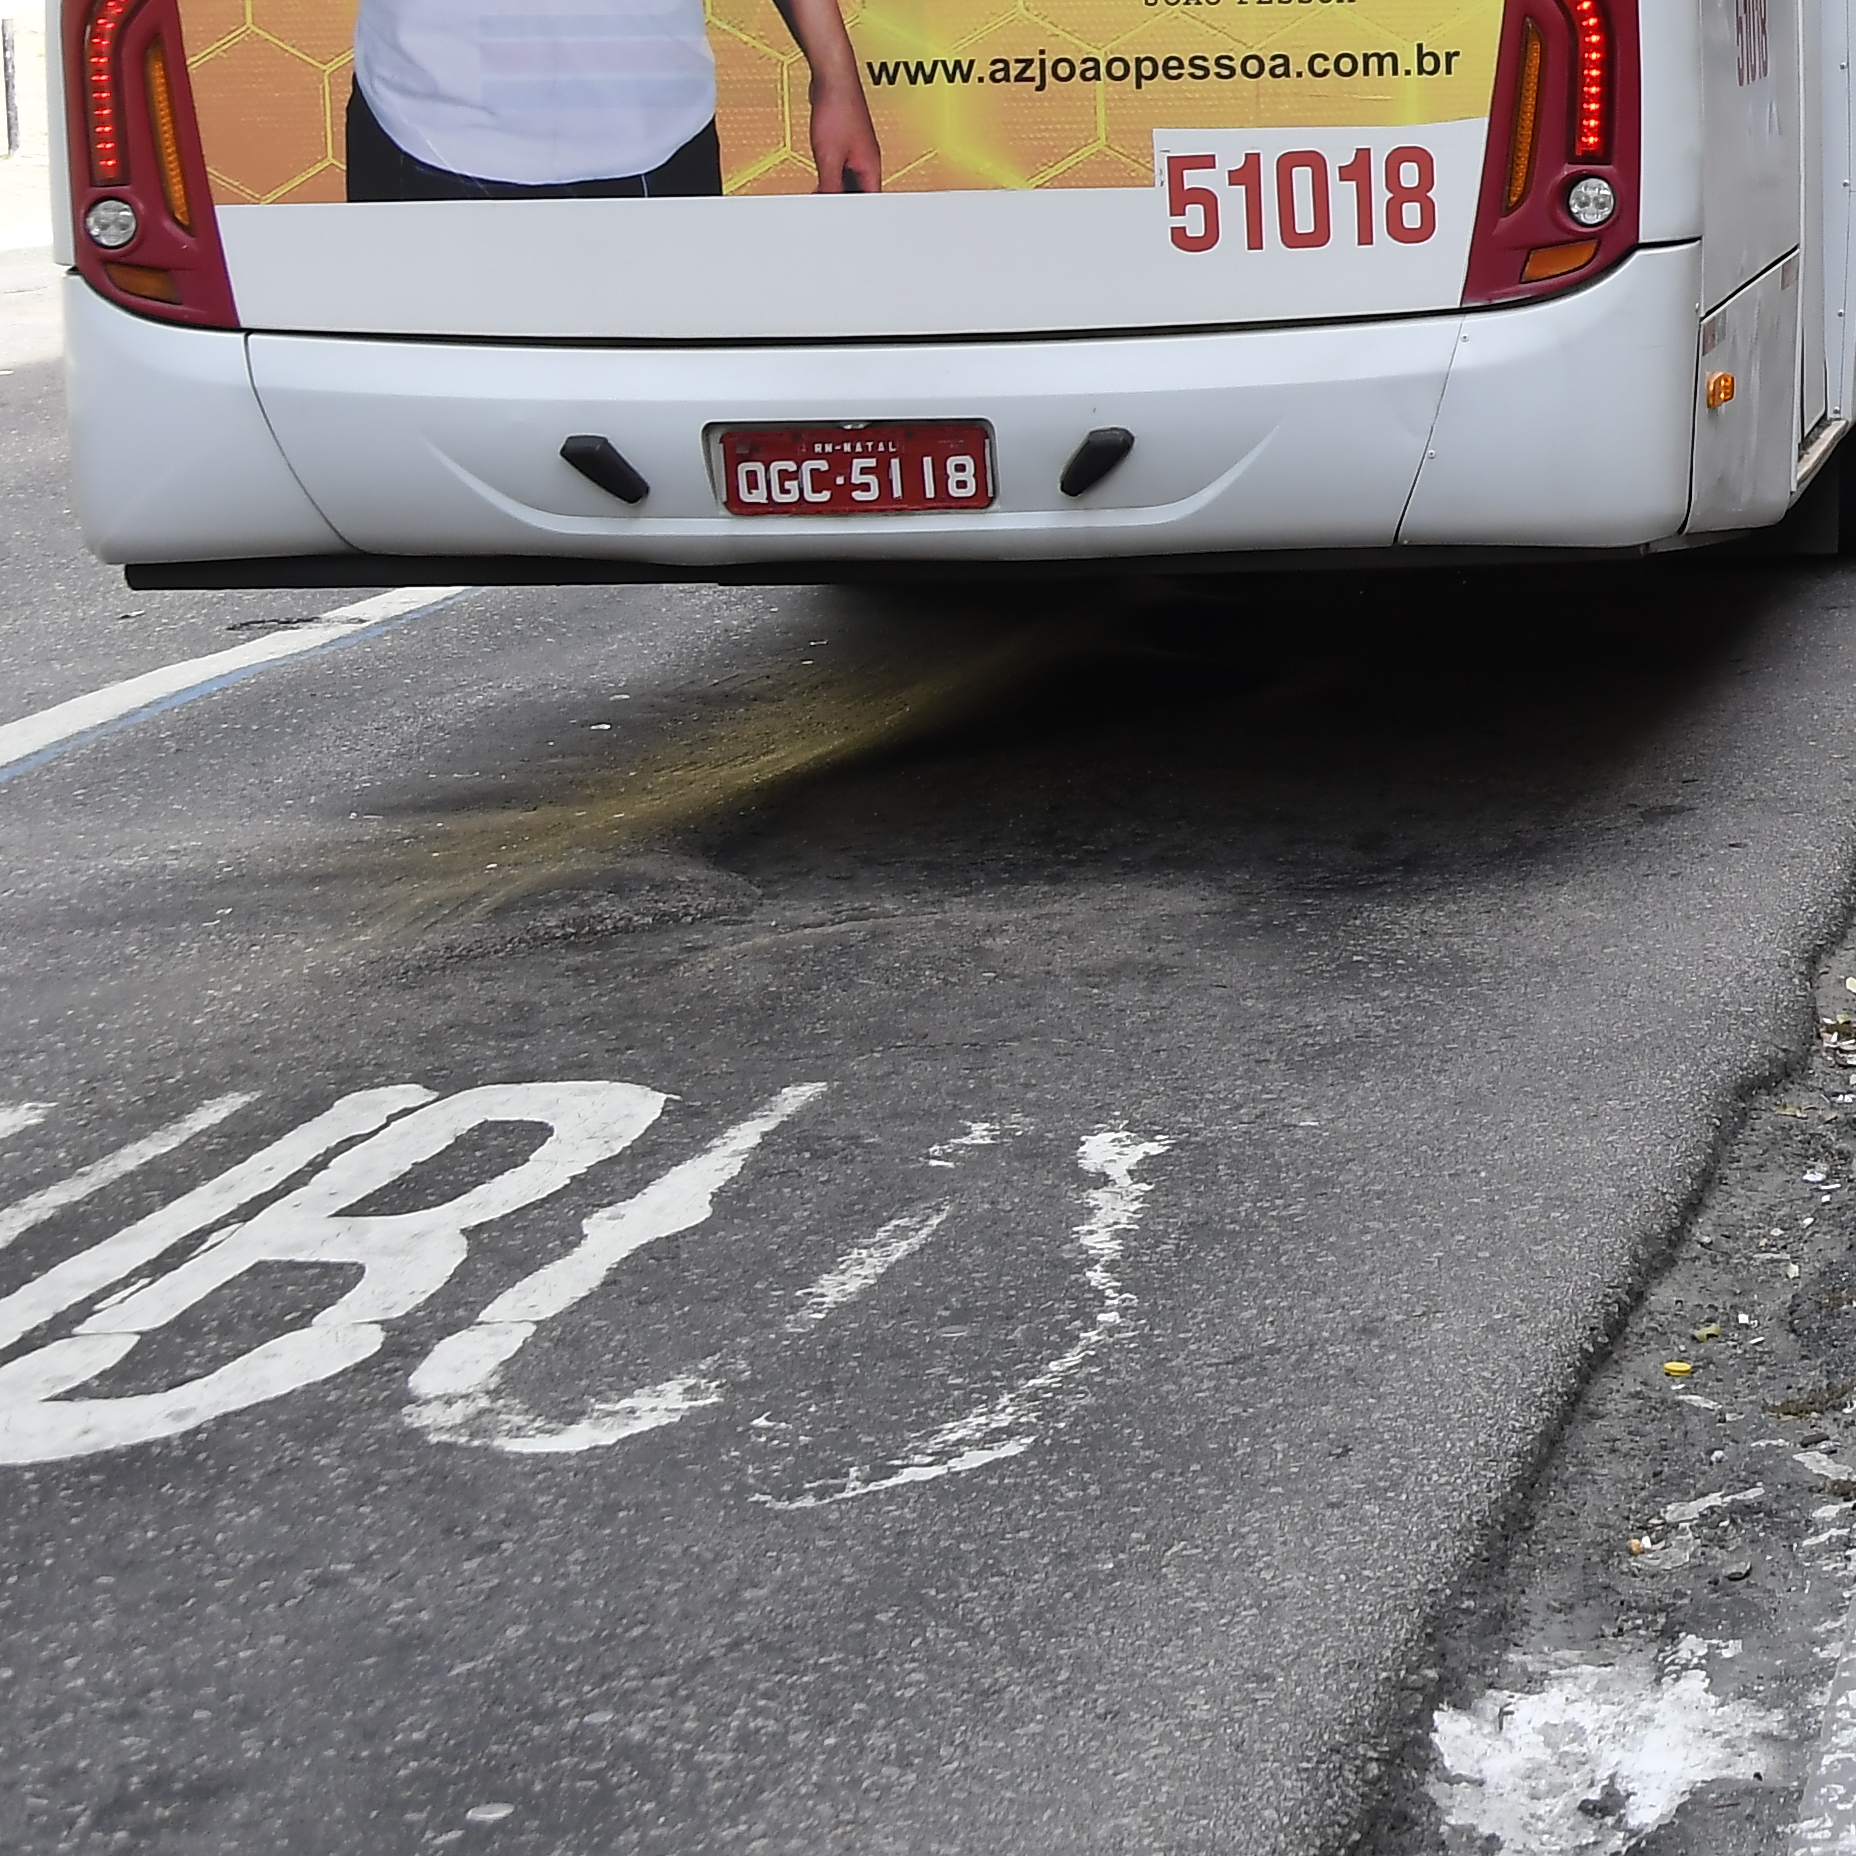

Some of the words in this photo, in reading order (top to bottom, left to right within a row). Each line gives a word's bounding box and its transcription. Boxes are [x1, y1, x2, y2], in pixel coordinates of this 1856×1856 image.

[866, 43, 1462, 91] www.azjoaopessoa.com.br
[1165, 145, 1437, 254] 51018
[813, 440, 898, 454] RN-NATAL
